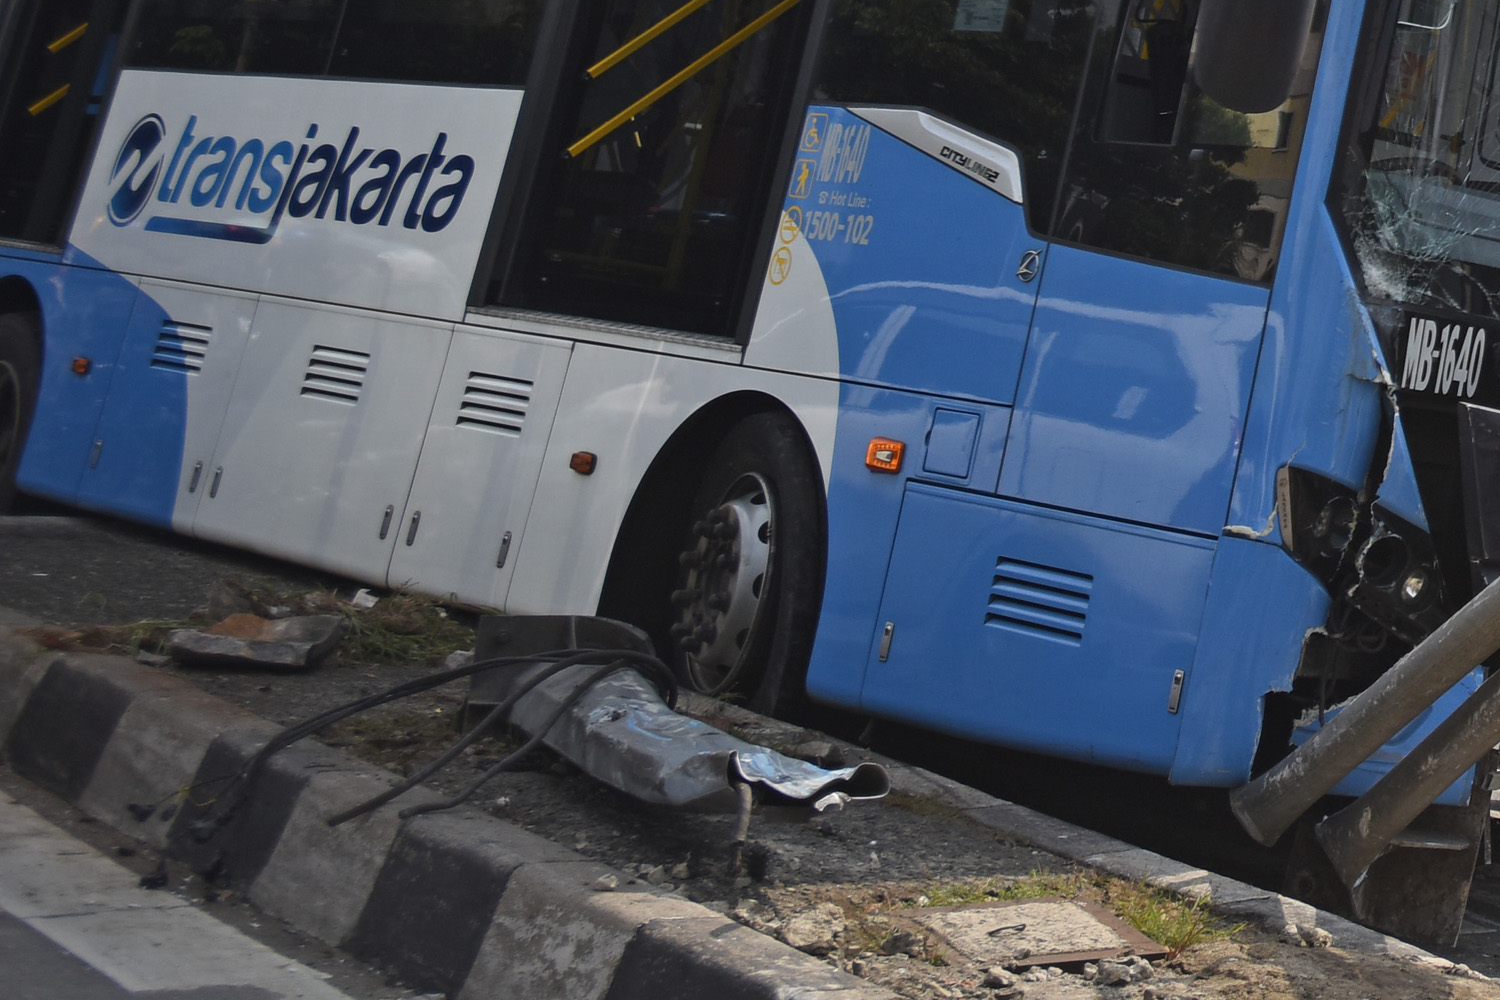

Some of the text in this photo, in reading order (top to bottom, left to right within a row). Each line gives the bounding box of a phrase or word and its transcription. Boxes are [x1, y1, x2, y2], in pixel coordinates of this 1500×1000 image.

[157, 114, 475, 244] transjakarta
[816, 123, 871, 183] MB-1640
[830, 190, 847, 206] Hot
[802, 211, 873, 246] 1500-102
[1401, 317, 1486, 398] MB-1640
